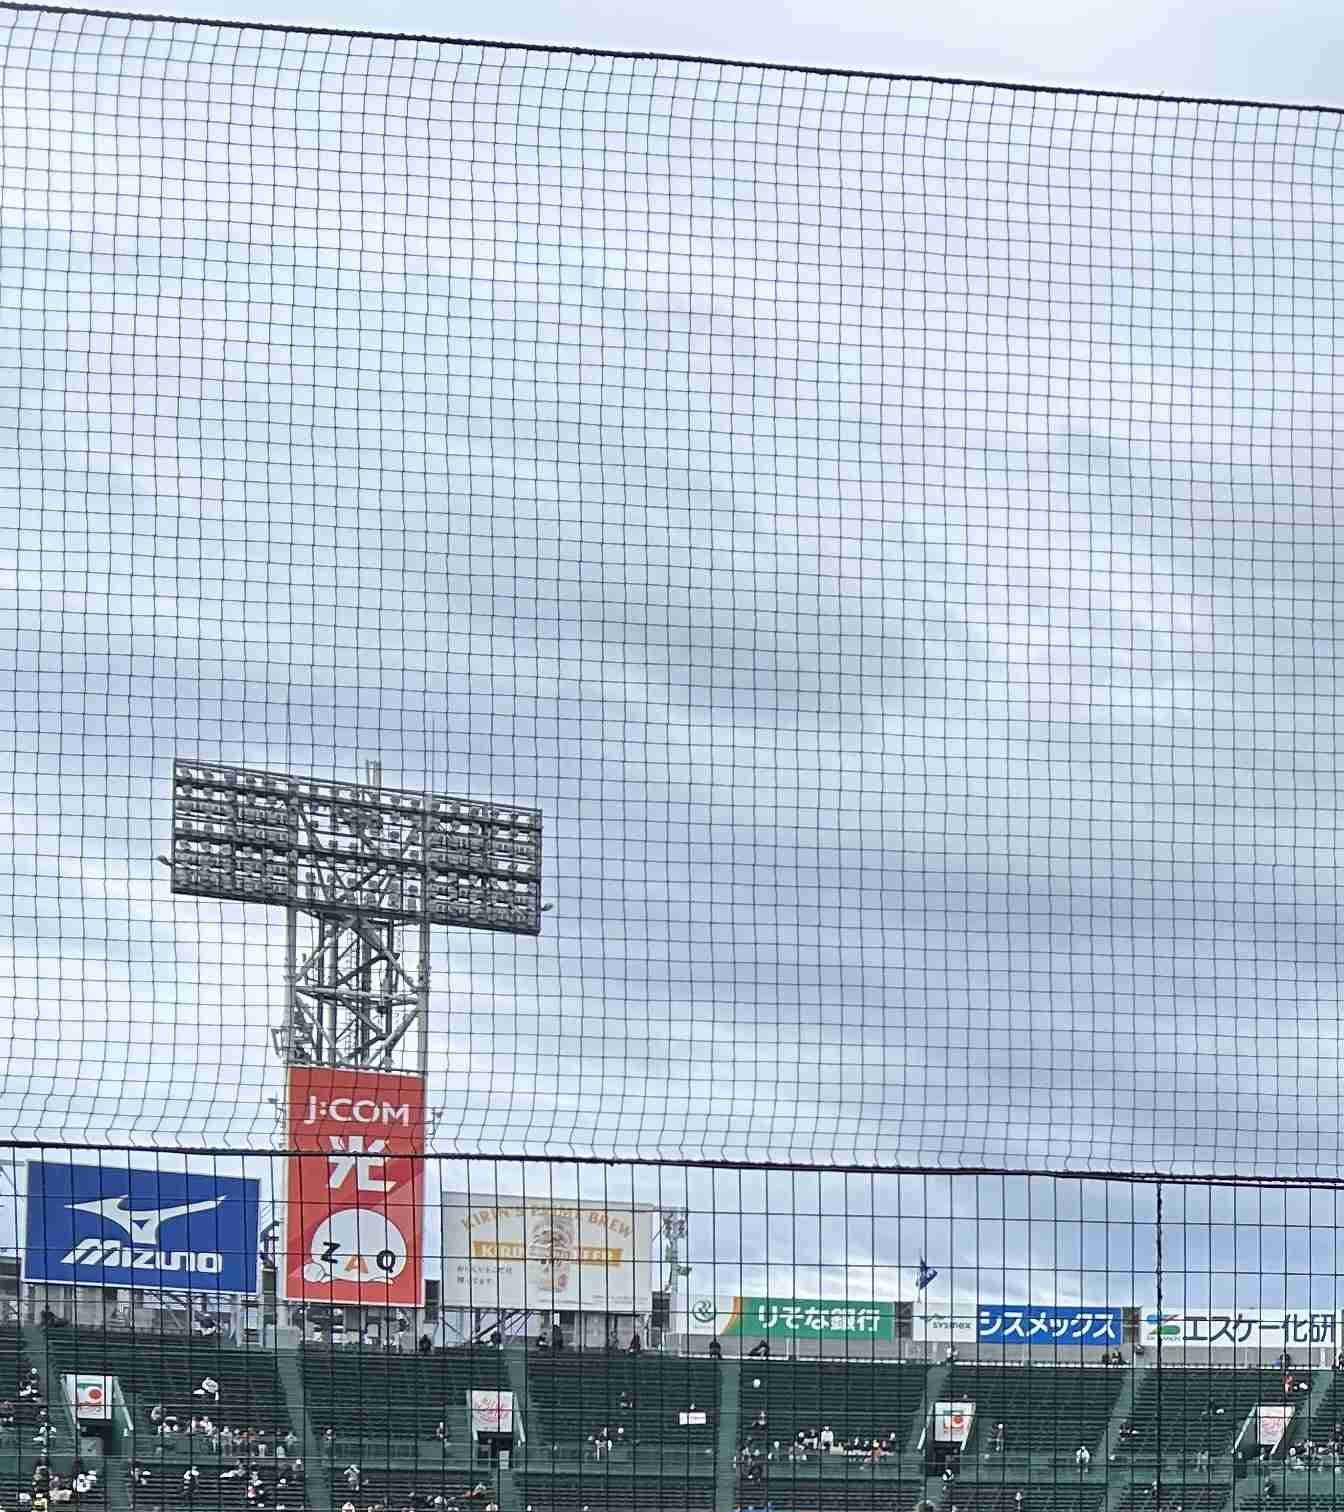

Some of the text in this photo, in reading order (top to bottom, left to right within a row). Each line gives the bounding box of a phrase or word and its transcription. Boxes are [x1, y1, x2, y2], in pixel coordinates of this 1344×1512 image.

[304, 1096, 409, 1127] J:COM
[327, 1135, 395, 1192] 光
[759, 1305, 880, 1331] りそな銀行
[980, 1311, 1115, 1340] シスメックス
[1183, 1313, 1336, 1343] エスケー化研
